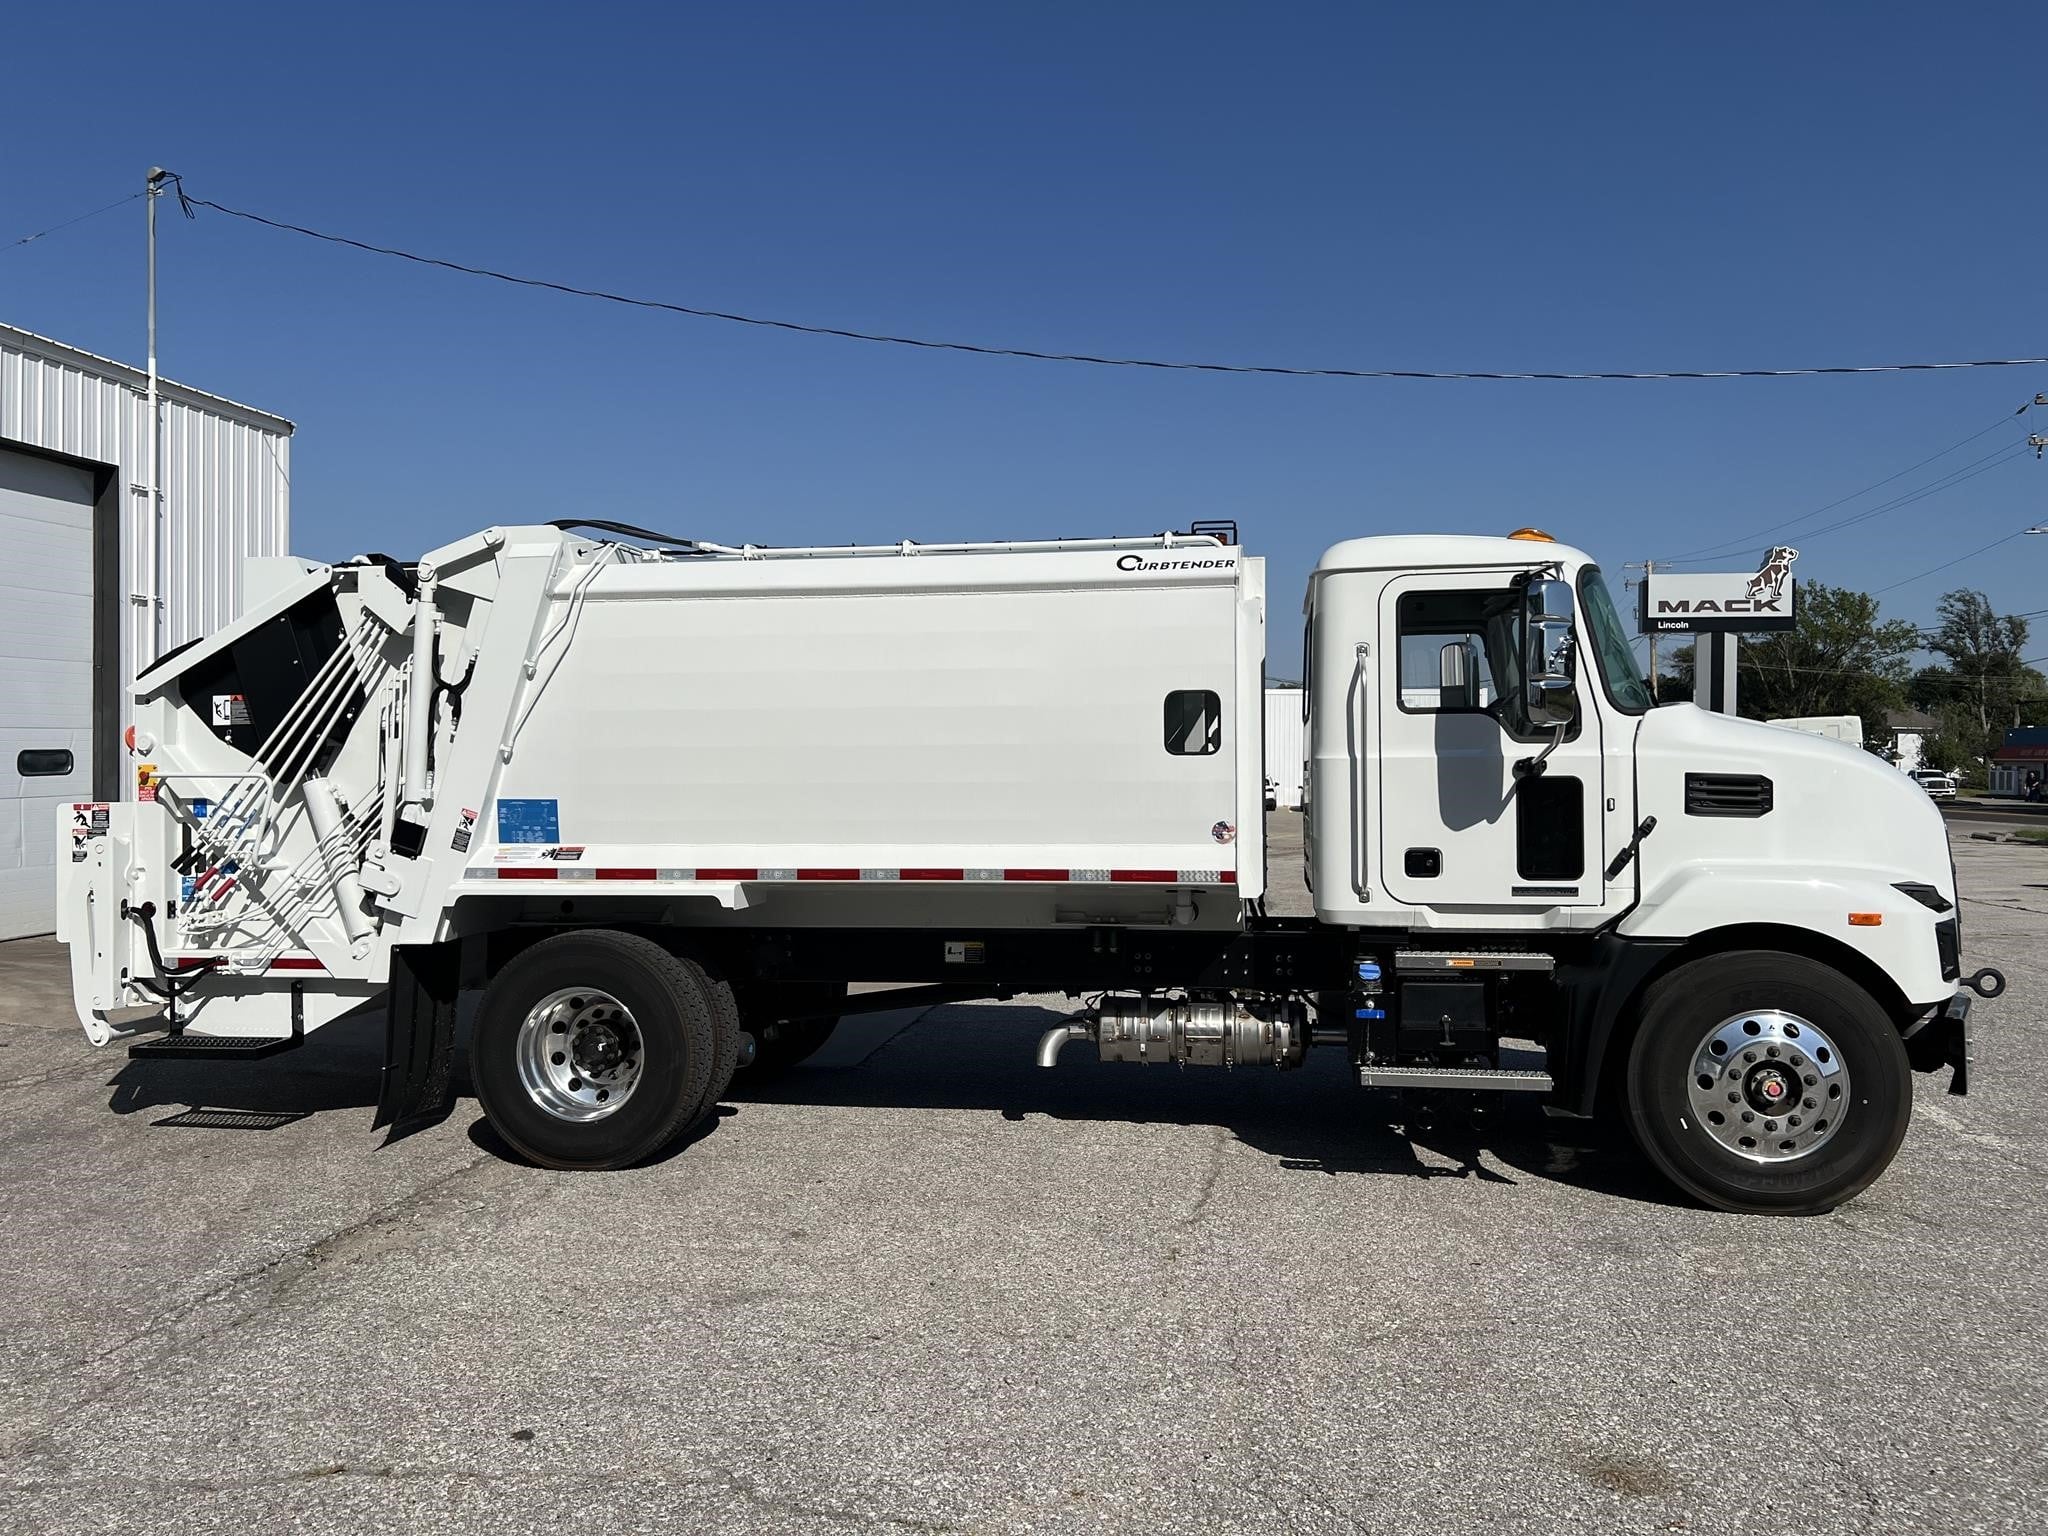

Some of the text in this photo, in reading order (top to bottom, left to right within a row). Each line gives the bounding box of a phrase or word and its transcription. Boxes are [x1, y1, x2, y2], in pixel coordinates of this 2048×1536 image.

[1116, 554, 1235, 571] CURBTENDER
[1658, 599, 1781, 613] MACK
[1657, 621, 1689, 629] Lincoln
